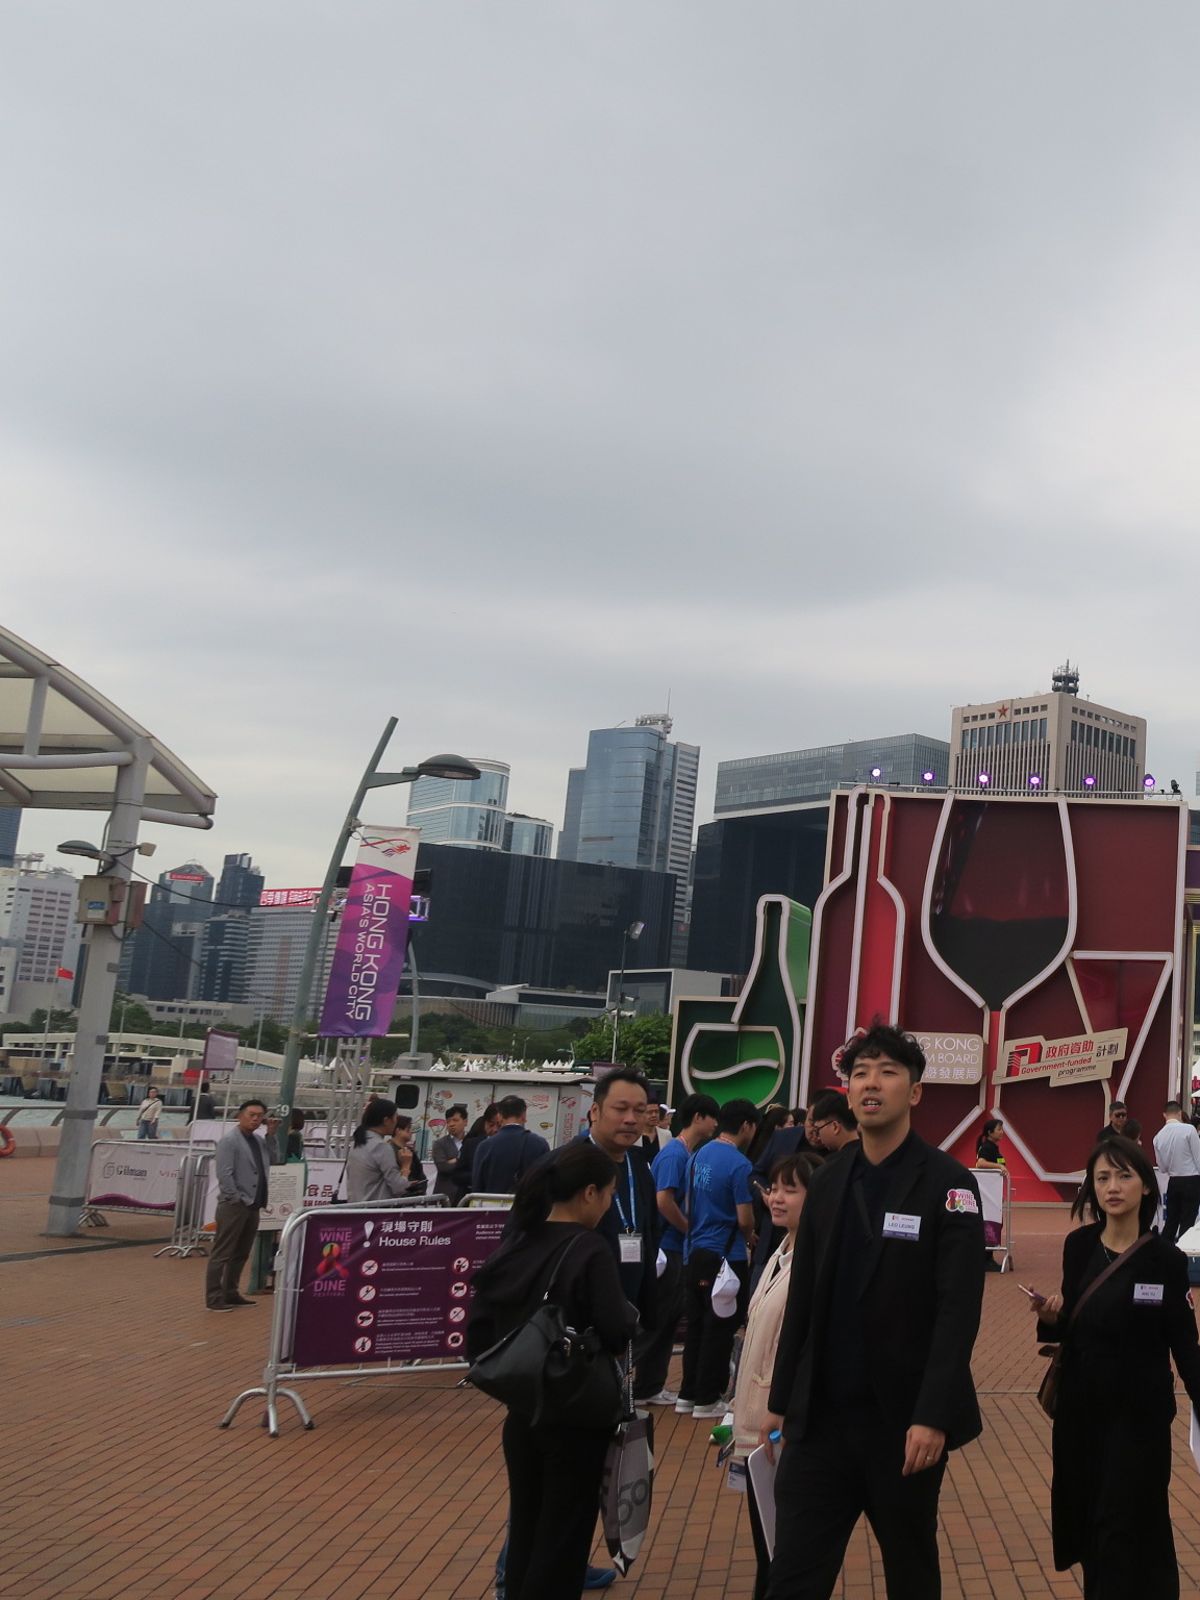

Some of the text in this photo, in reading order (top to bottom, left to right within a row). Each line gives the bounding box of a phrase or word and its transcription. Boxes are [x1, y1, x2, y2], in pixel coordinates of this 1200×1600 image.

[345, 883, 375, 1020] ASIA'S WORLD CITY
[355, 883, 392, 1021] HONG KONG
[934, 1036, 980, 1051] KONG
[1045, 1040, 1120, 1060] 政府資助 計劃
[937, 1053, 979, 1064] BOARD
[1021, 1056, 1093, 1075] Government-funded
[1057, 1063, 1097, 1078] programme
[380, 1220, 434, 1233] 現場守則
[319, 1231, 353, 1242] WINE
[379, 1235, 452, 1248] House Rules
[313, 1279, 347, 1293] DINE
